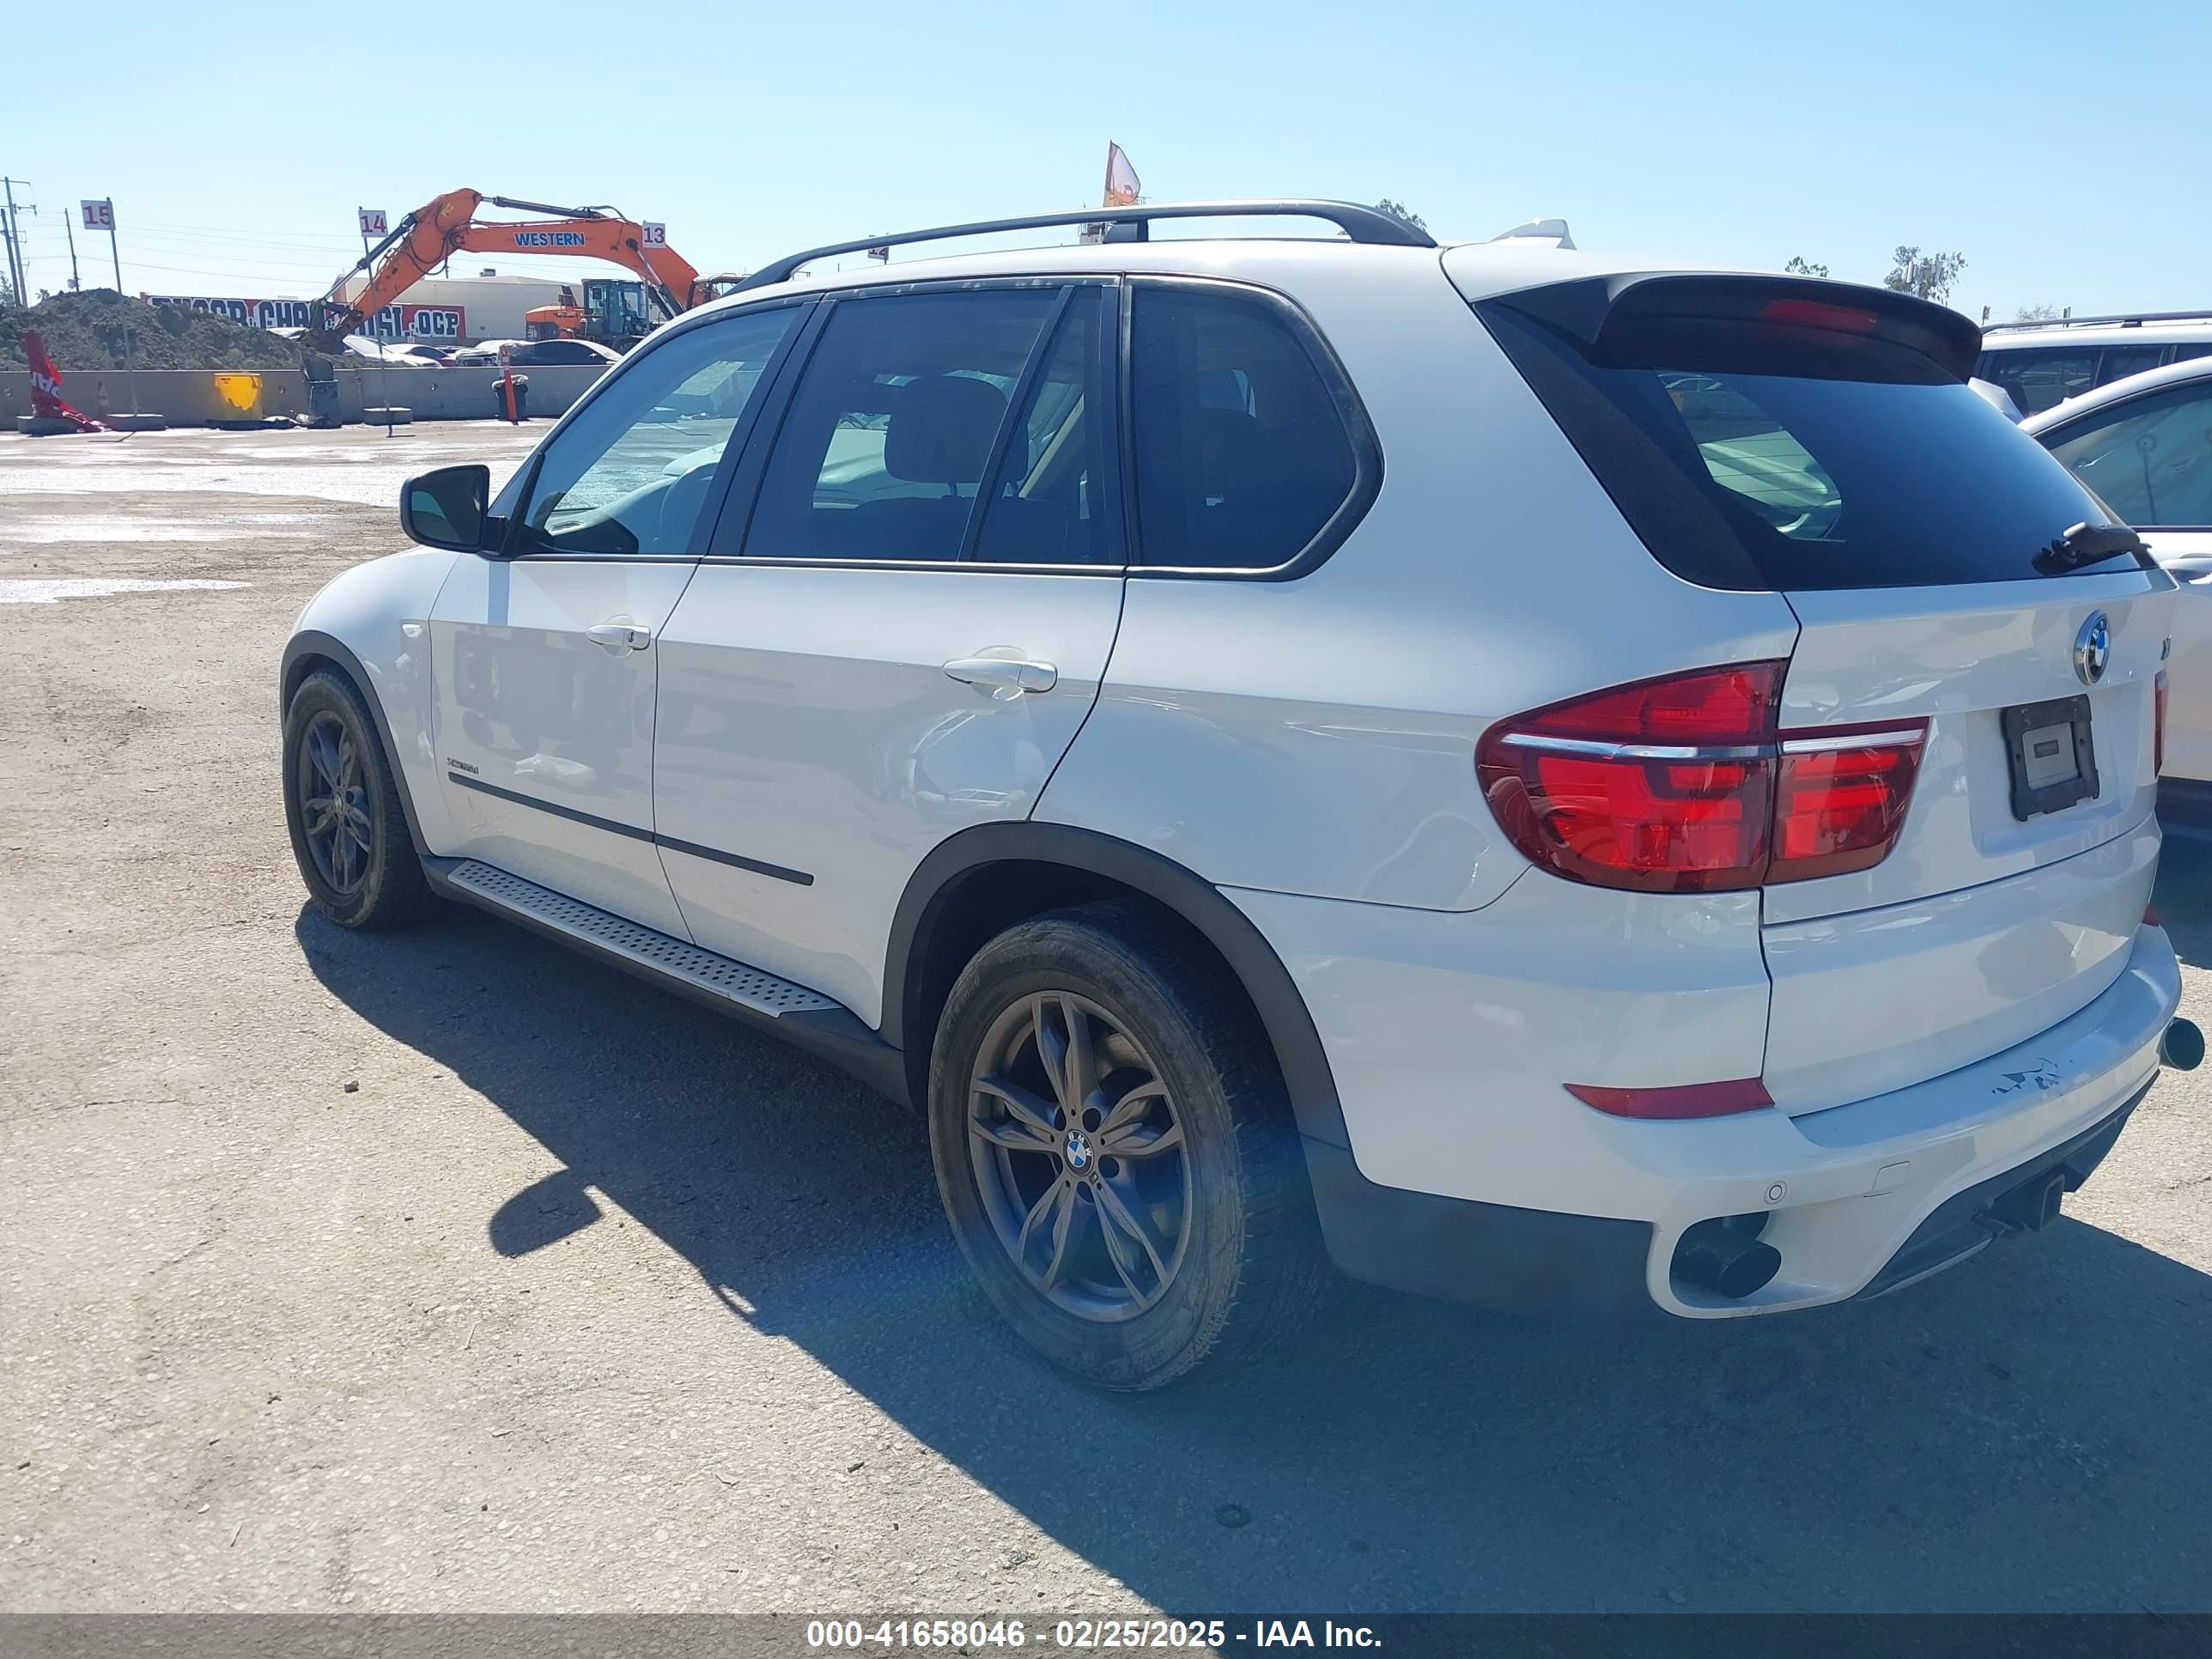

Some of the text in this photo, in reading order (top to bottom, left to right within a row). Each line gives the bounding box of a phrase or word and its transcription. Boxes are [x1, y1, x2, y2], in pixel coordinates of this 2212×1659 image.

[83, 205, 111, 225] 15
[361, 215, 386, 233] 14
[514, 232, 586, 247] WESTERN
[644, 227, 665, 244] 13
[1067, 1132, 1092, 1157] BMW
